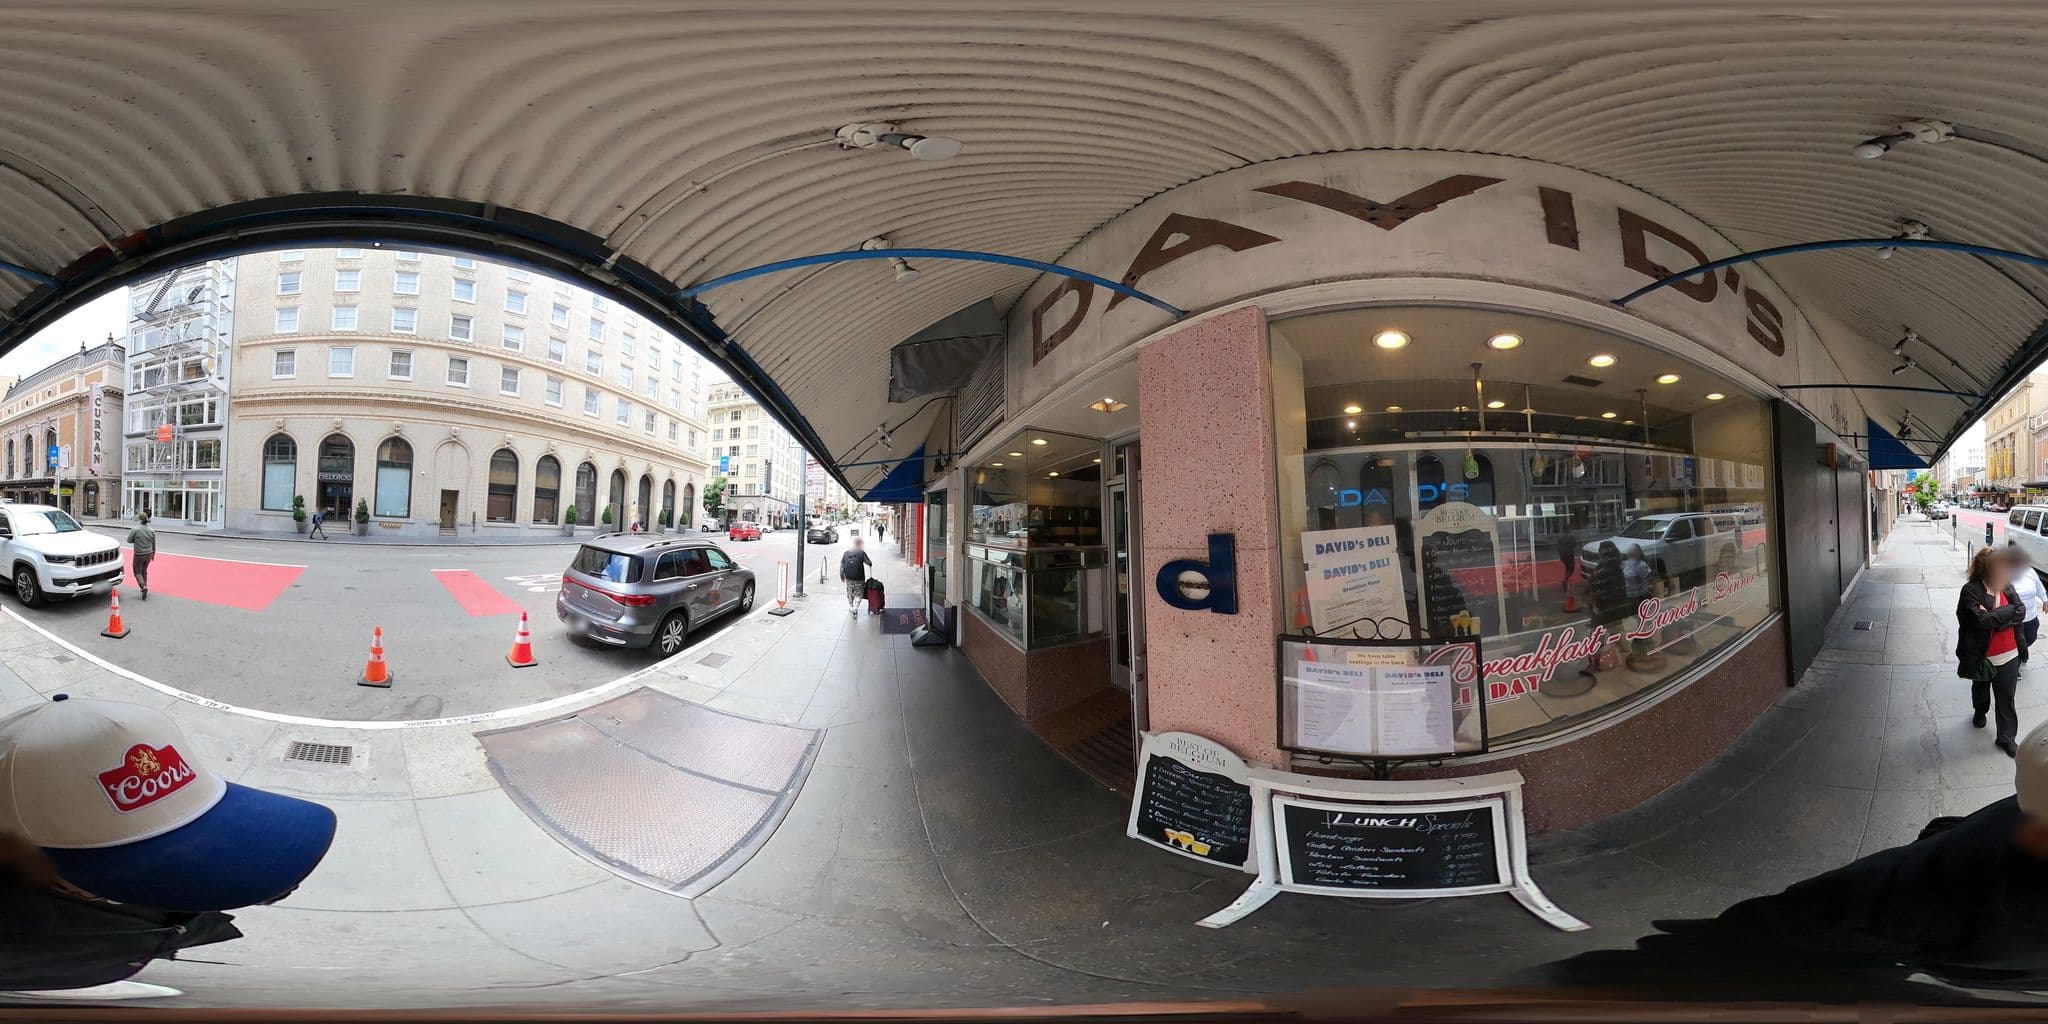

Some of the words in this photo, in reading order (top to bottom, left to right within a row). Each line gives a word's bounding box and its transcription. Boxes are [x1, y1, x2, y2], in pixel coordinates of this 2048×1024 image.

[1032, 174, 1785, 368] DAVID'S
[94, 397, 102, 464] CURRAN
[1315, 540, 1365, 556] DAVID's
[1367, 536, 1390, 548] DELI
[1156, 533, 1237, 614] d
[1323, 563, 1368, 580] DAVID's
[1369, 558, 1390, 570] DELI
[1422, 626, 1606, 684] Breakfast
[1626, 586, 1698, 640] Lunch
[1713, 572, 1757, 601] Dinner
[1490, 674, 1542, 700] DAY
[1170, 741, 1226, 767] BELGIUM
[109, 760, 191, 804] Coors
[1333, 813, 1418, 828] LUNCH
